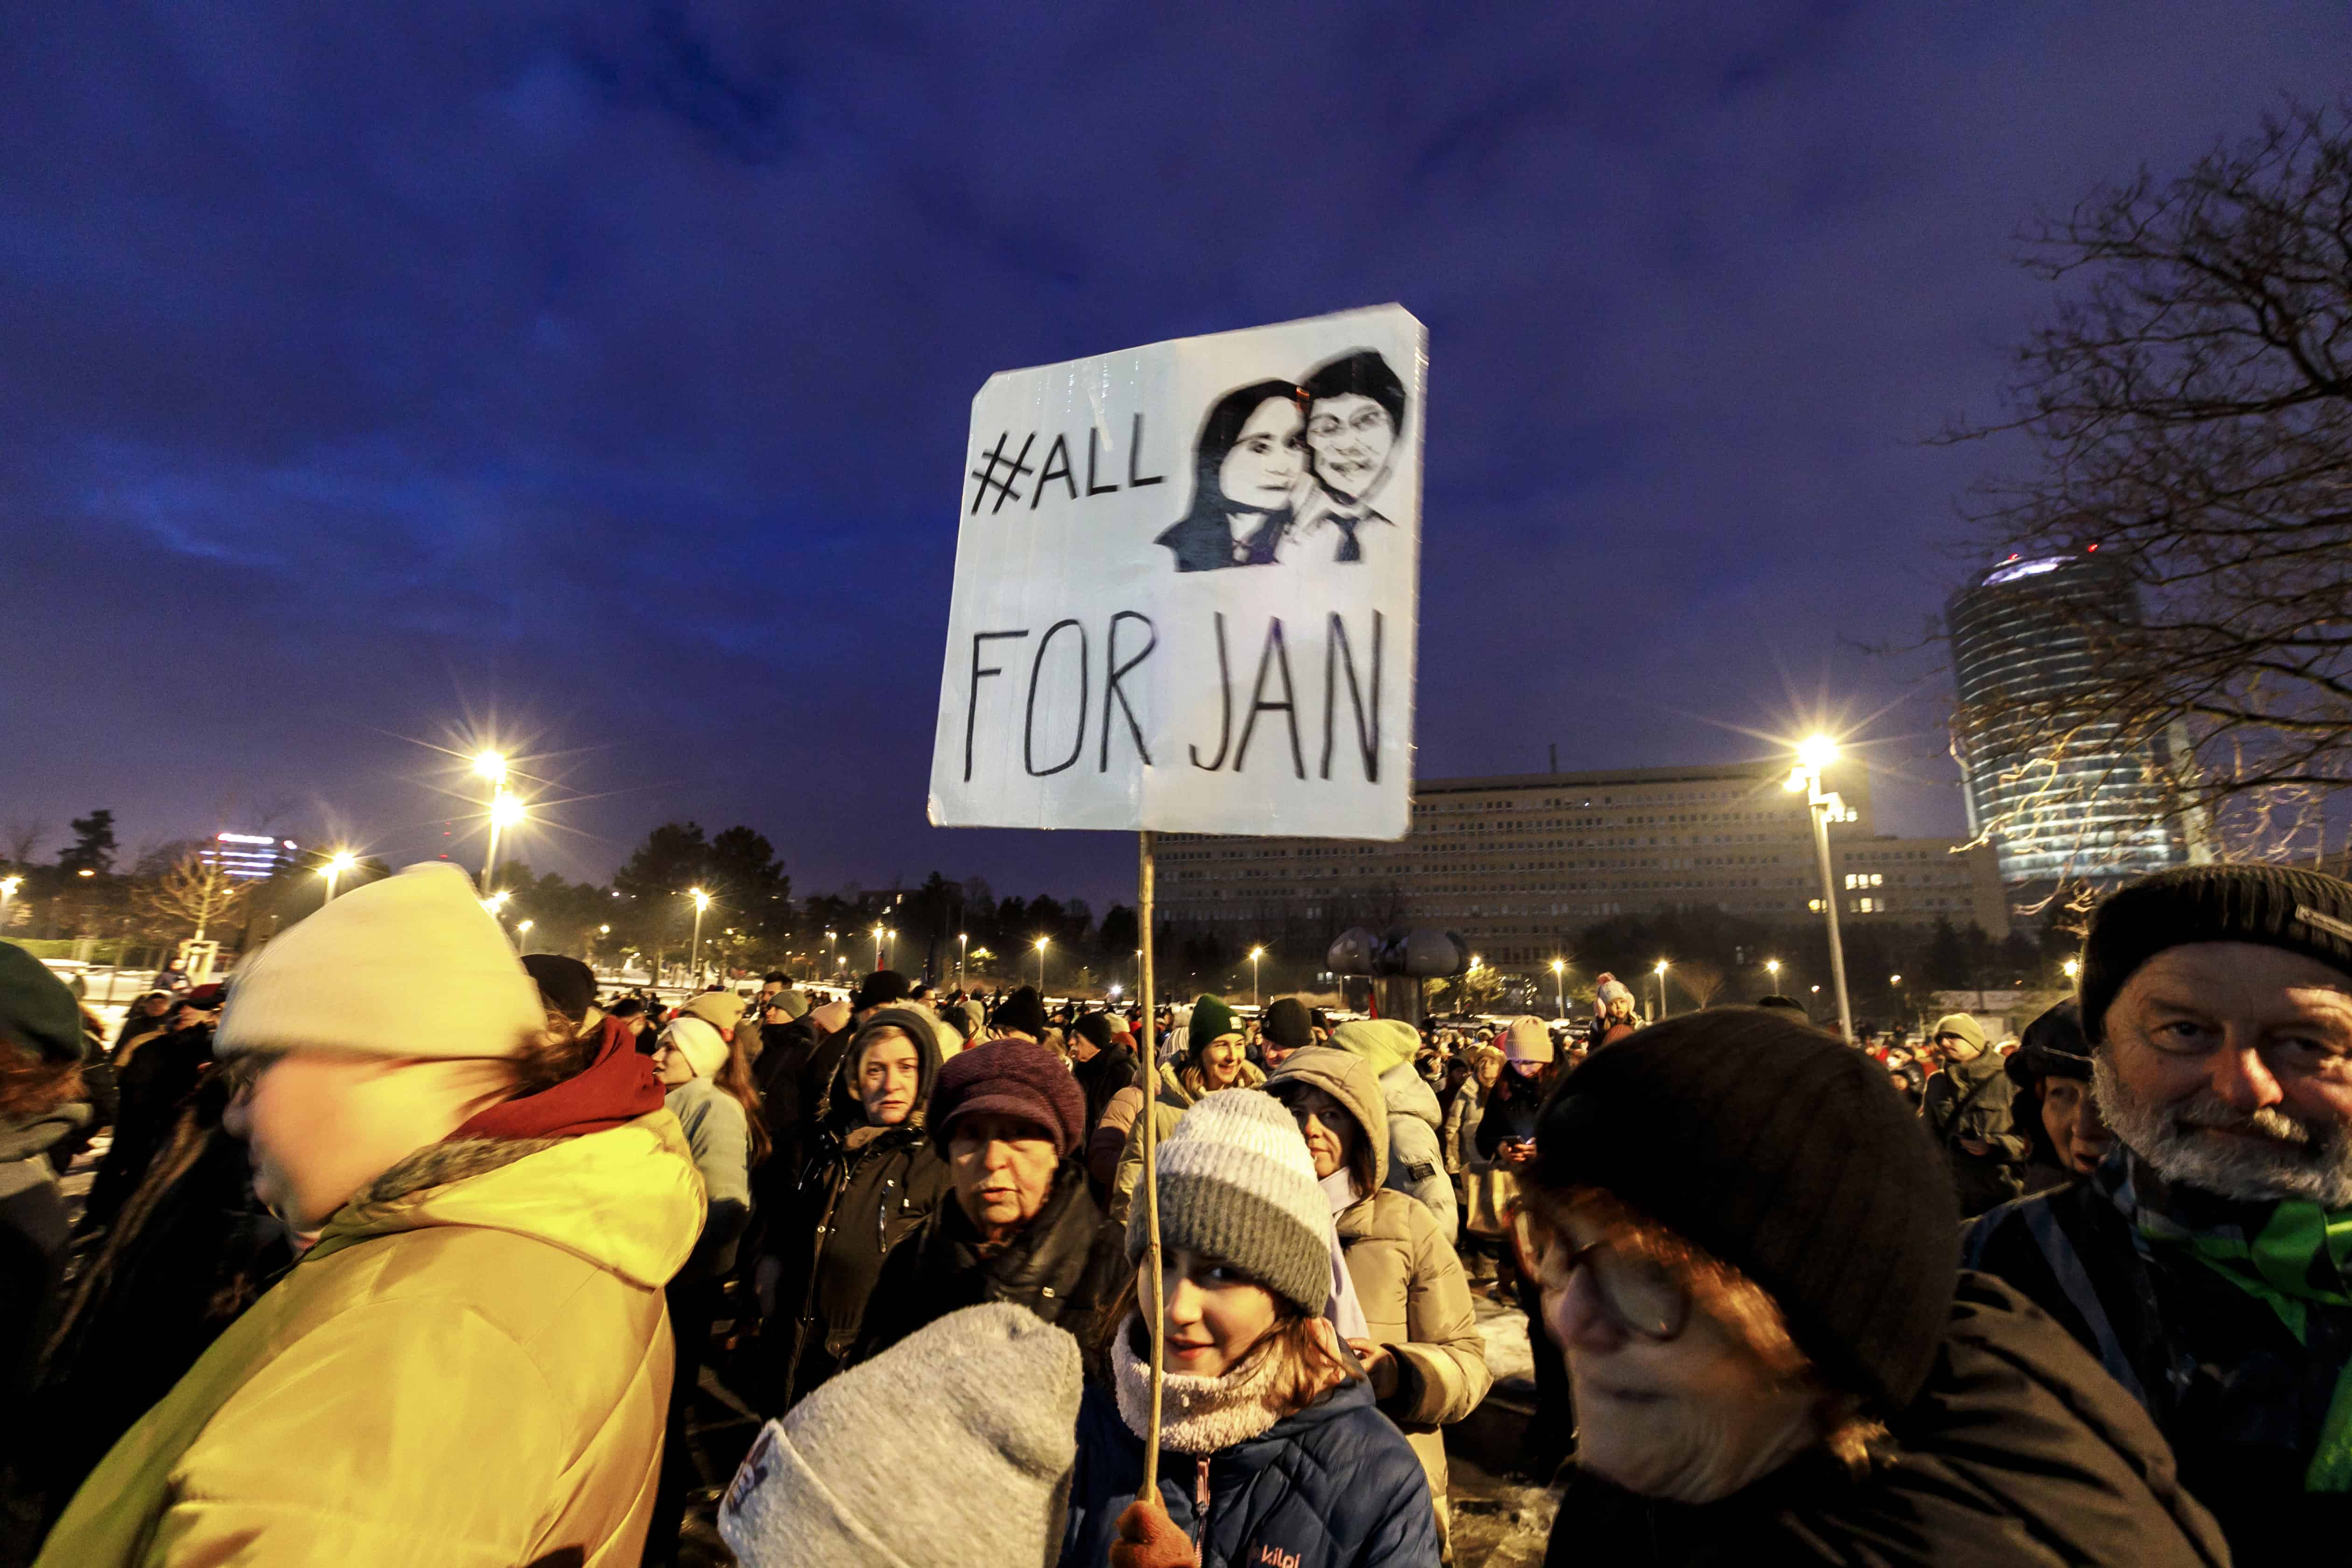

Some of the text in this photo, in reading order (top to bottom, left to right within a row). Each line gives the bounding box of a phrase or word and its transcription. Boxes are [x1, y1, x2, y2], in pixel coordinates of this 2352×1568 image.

[971, 413, 1166, 515] #ALL
[965, 609, 1385, 783] FOR JAN
